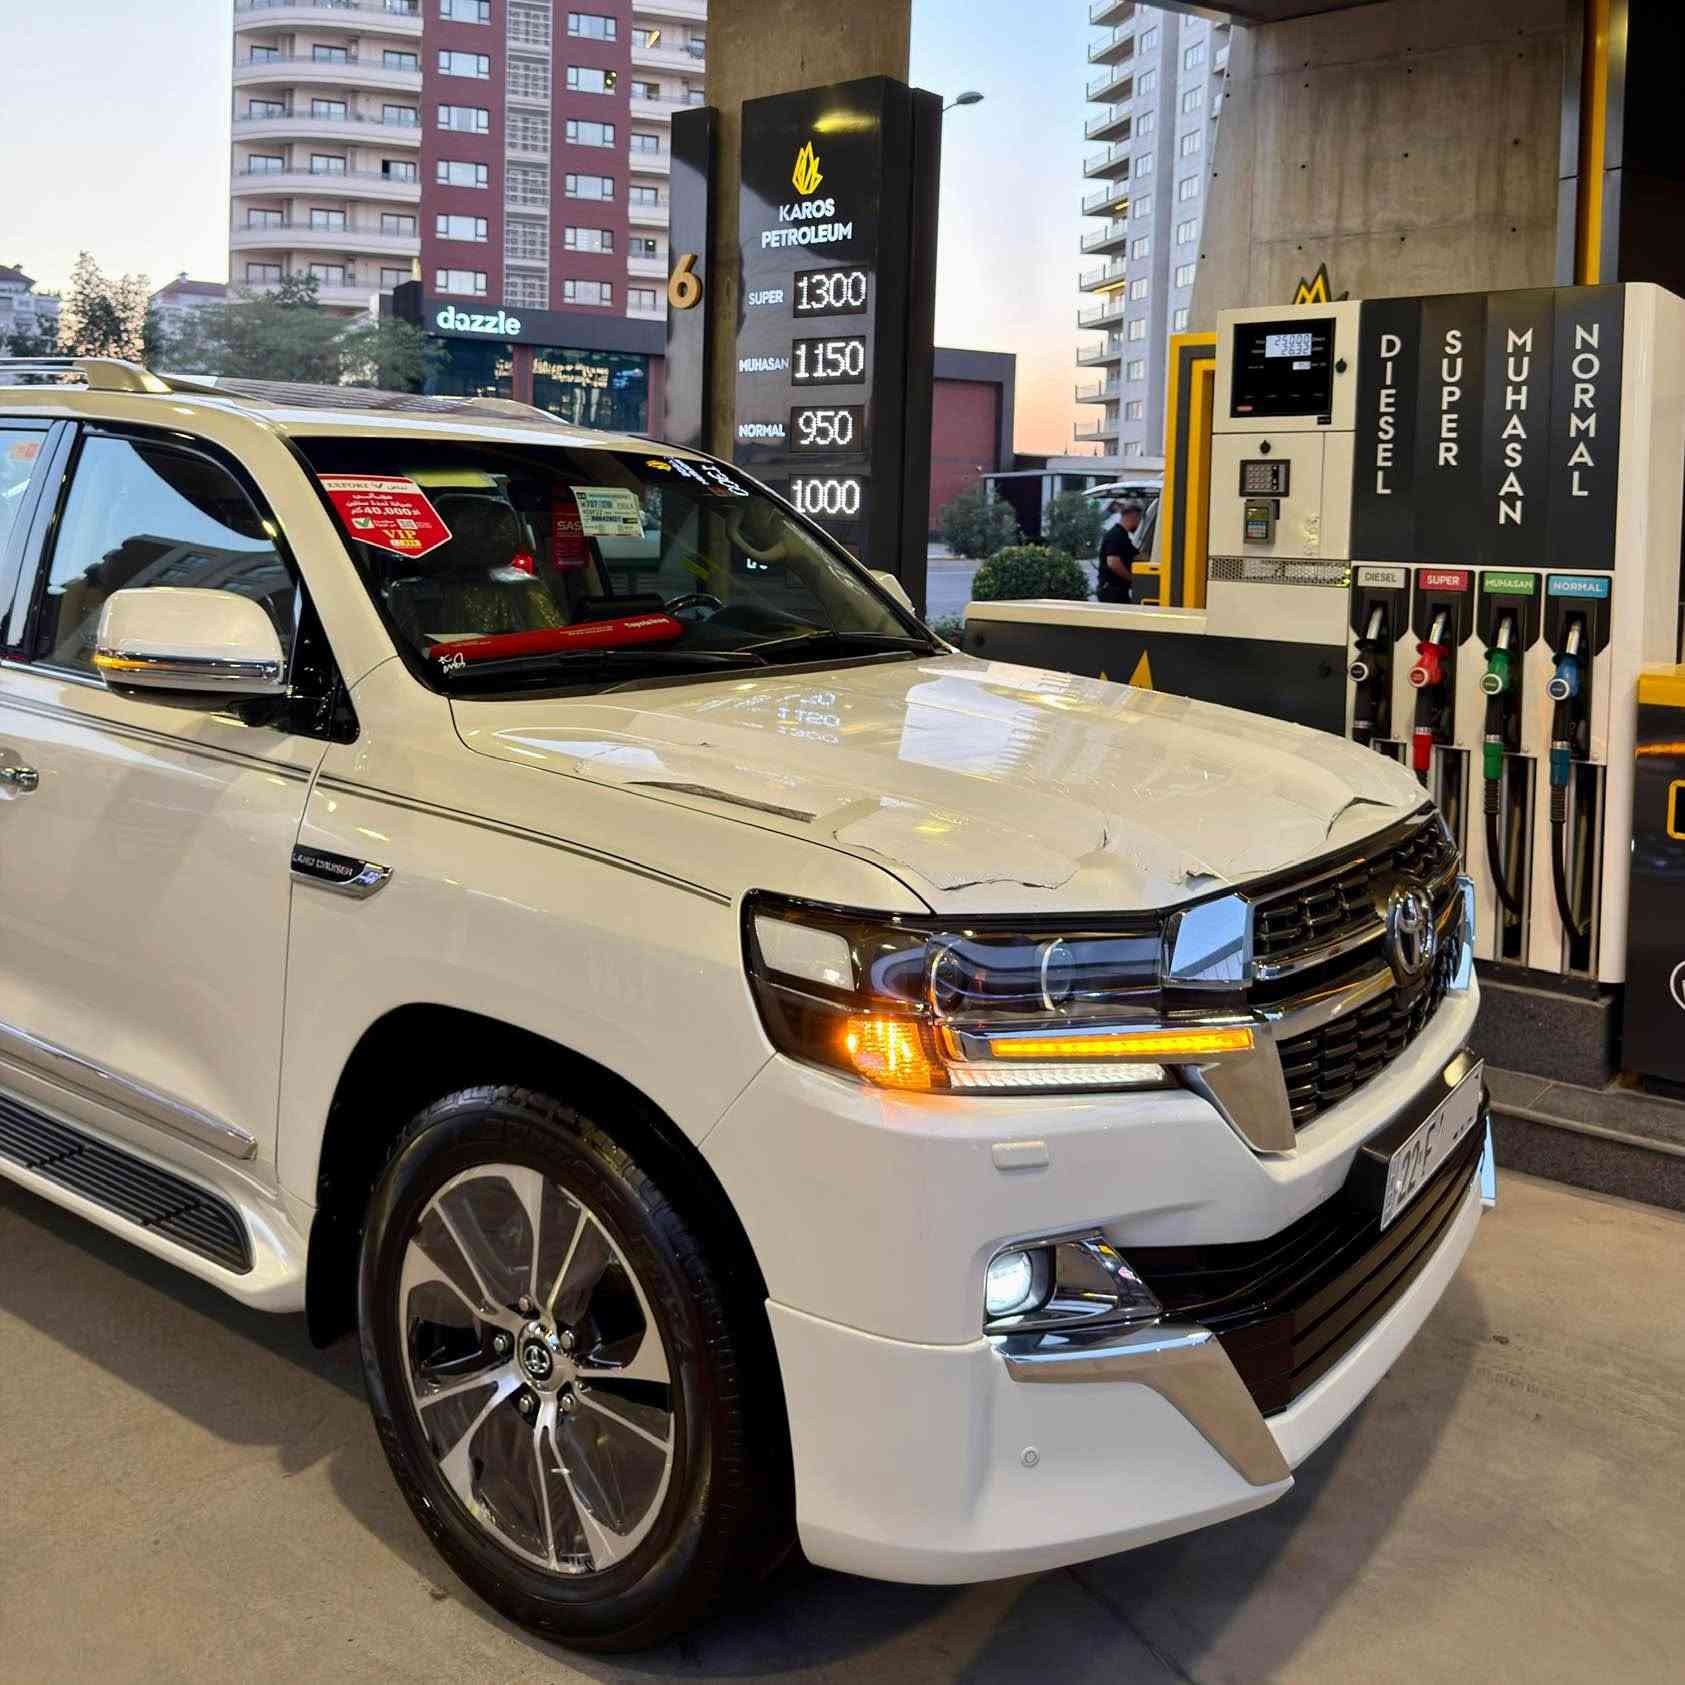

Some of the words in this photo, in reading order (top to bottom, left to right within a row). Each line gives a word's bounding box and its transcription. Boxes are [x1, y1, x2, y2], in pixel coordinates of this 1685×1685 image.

[779, 198, 836, 222] KAROS
[761, 222, 853, 249] PETROLEUM
[668, 252, 704, 310] 6
[748, 289, 784, 305] SUPER
[797, 271, 867, 310] 1300
[436, 305, 521, 336] dazzle
[738, 357, 790, 373] MUHASAN
[795, 341, 865, 378] 1150
[1376, 334, 1402, 495] DIESEL
[1438, 330, 1463, 466] SUPER
[1567, 323, 1601, 497] NORMAL
[738, 424, 786, 438] NORMAL
[799, 411, 853, 445] 950
[1498, 327, 1534, 526] MUHASAN
[791, 479, 861, 514] 1000
[382, 529, 417, 539] VIP
[1364, 571, 1398, 584] DIESEL
[1426, 574, 1461, 587] SUPER
[1552, 580, 1603, 594] NORMAL
